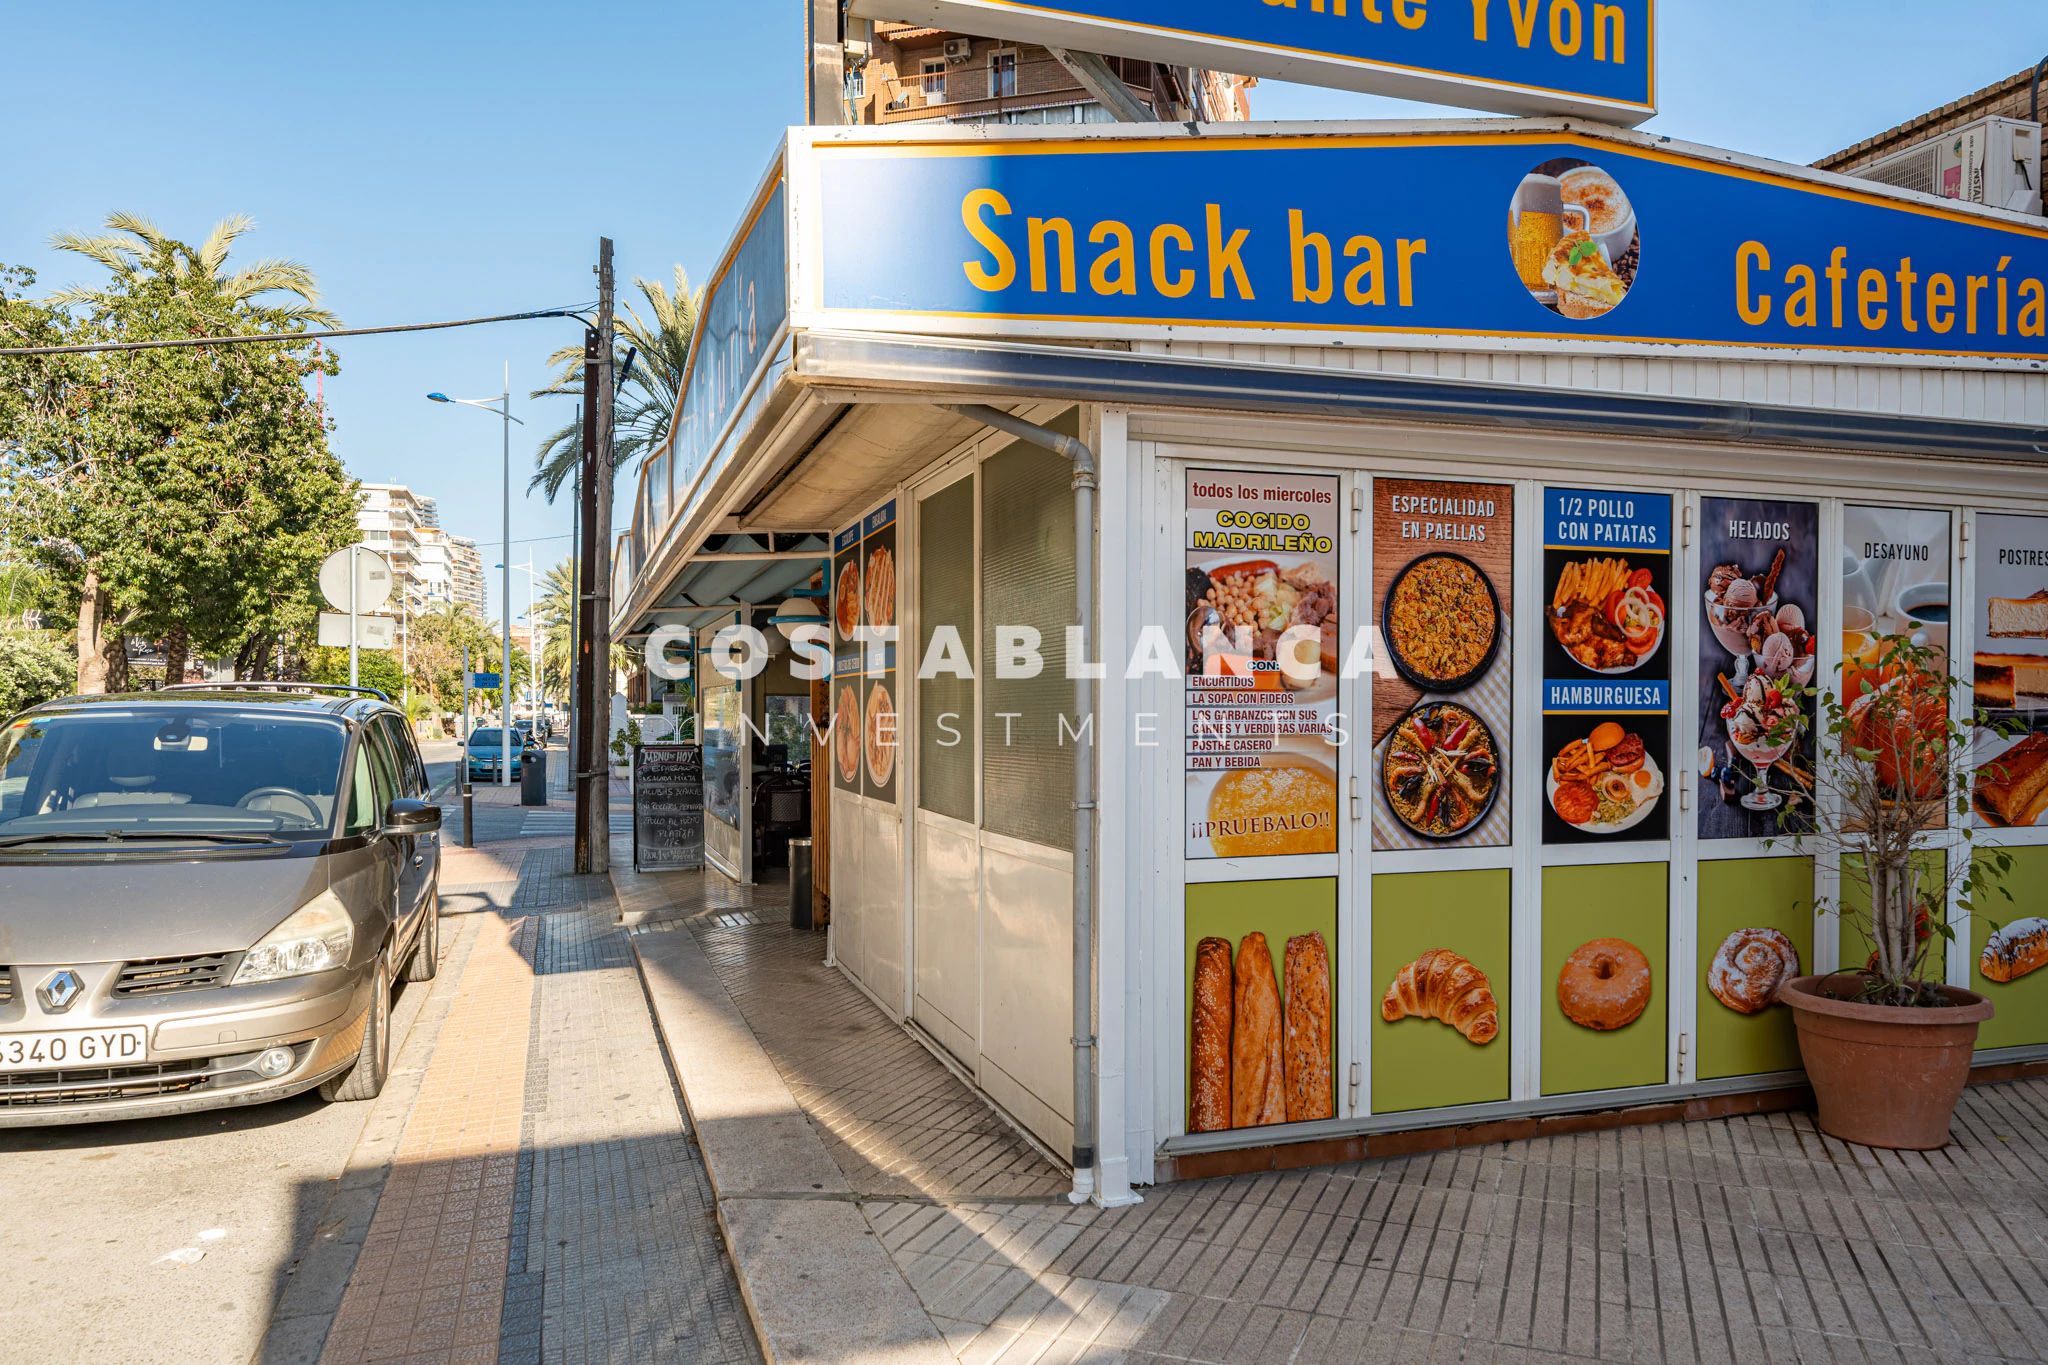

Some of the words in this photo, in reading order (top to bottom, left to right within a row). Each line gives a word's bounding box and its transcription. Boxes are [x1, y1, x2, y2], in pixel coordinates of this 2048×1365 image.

[961, 188, 1255, 300] Snack
[1288, 208, 1427, 307] bar
[1735, 240, 2046, 337] Cafetería
[1192, 482, 1233, 499] todos
[1238, 484, 1259, 500] los
[1263, 486, 1332, 504] miercoles
[1392, 495, 1495, 517] ESPECIALIDAD
[1559, 497, 1582, 516] 1/2
[1588, 499, 1634, 519] POLLO
[1217, 510, 1310, 531] COCIDO
[1729, 520, 1790, 540] HELADOS
[1402, 521, 1420, 539] EN
[1426, 522, 1486, 541] PAELLAS
[1558, 521, 1588, 540] CON
[1594, 523, 1657, 543] PATATAS
[1193, 531, 1332, 553] MADRILEÑO
[1864, 542, 1928, 561] DESAYUNO
[1999, 548, 2048, 566] POSTRES
[1247, 661, 1280, 671] CON:
[1192, 676, 1254, 687] ENCURTIDOS
[1192, 693, 1205, 704] LA
[1208, 693, 1234, 704] SOPA
[1237, 693, 1257, 704] CON
[1259, 693, 1294, 704] FIDEOS
[1551, 686, 1661, 705] HAMBURGUESA
[1192, 710, 1211, 721] LOS
[1214, 710, 1273, 721] GARBANZOS
[1277, 710, 1296, 721] CON
[1298, 710, 1317, 721] SUS
[1192, 723, 1232, 734] CARNES
[1235, 723, 1241, 734] Y
[1244, 723, 1296, 734] VERDURAS
[1298, 723, 1333, 734] VARIAS
[1192, 740, 1231, 750] POSTRE
[1233, 740, 1272, 750] CASERO
[643, 751, 669, 764] MENU
[1192, 757, 1212, 767] PAN
[1215, 757, 1222, 767] Y
[1224, 757, 1261, 767] BEBIDA
[1192, 811, 1330, 839] ¡¡PRUEBALO!!
[0, 1037, 66, 1064] 340
[80, 1033, 137, 1059] GYD
